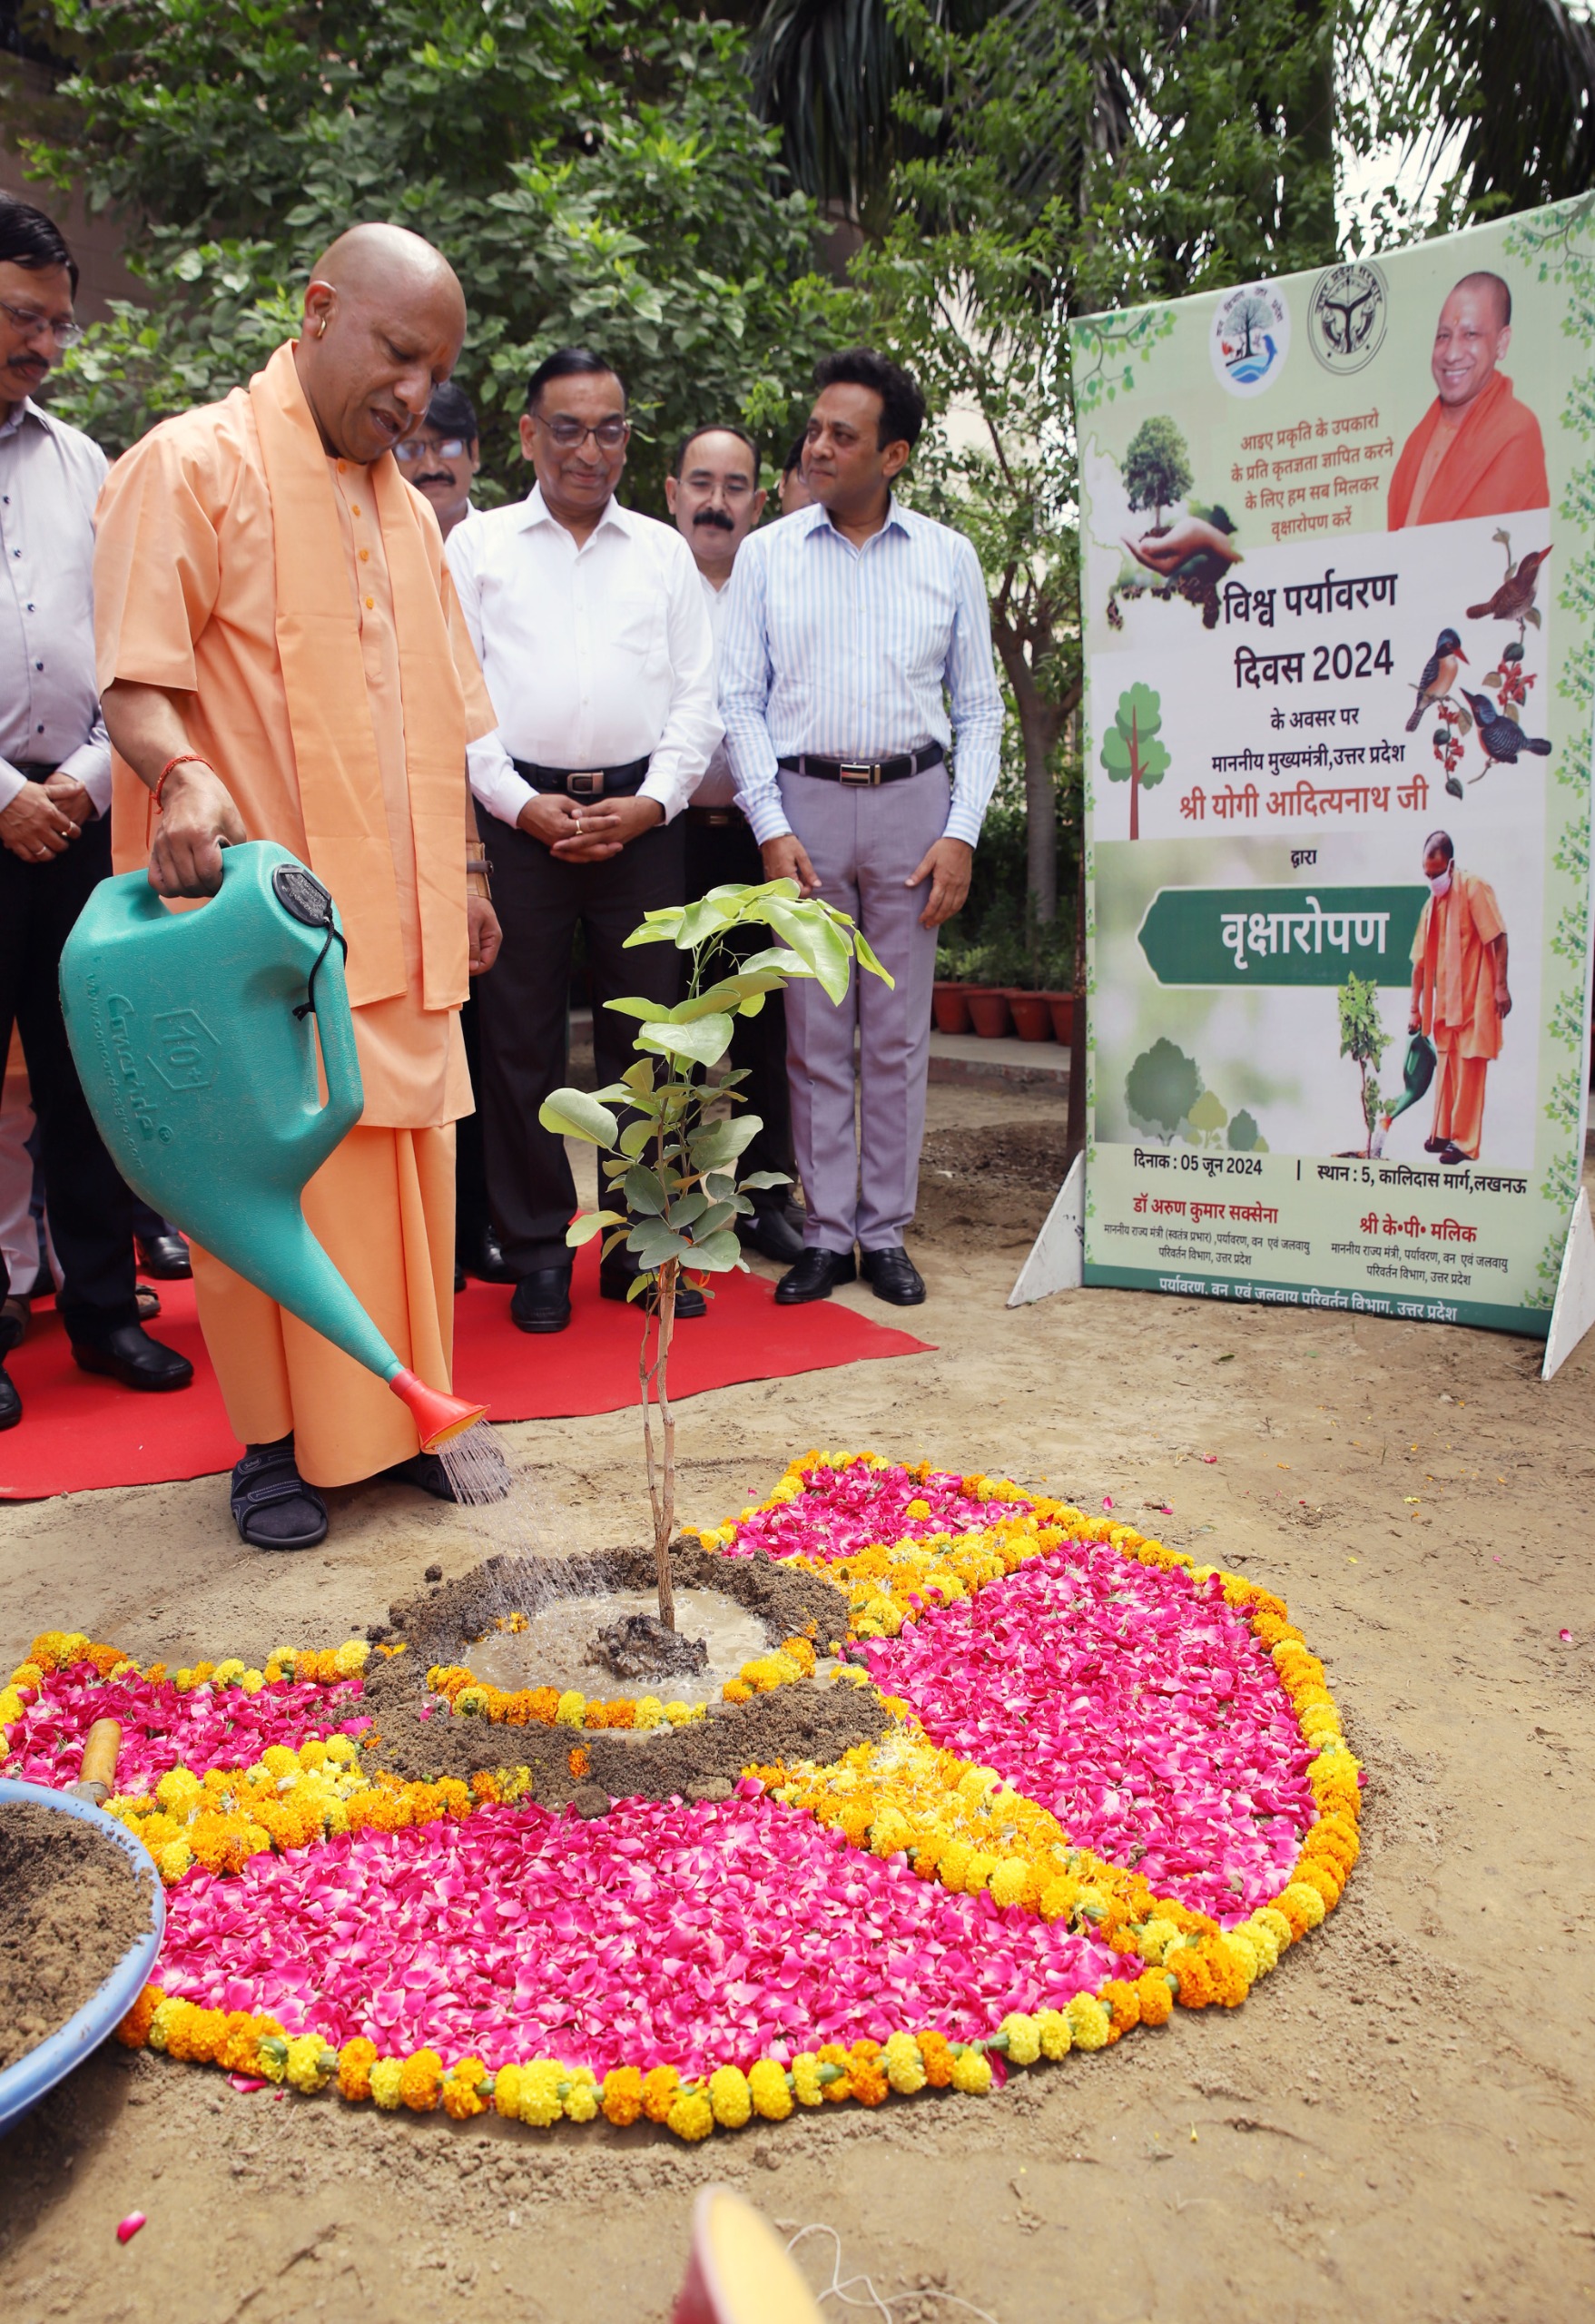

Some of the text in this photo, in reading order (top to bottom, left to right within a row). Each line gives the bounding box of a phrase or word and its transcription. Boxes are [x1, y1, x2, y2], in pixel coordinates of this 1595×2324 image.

[1241, 407, 1379, 450] आइए प्रकृति के उपकारो
[1231, 436, 1394, 482] के प्रति कृतज्ञता ज्ञापित करने
[1245, 476, 1380, 509] के लिए हम सब मिलकर
[1271, 506, 1353, 542] वृक्षारोपण करें
[1223, 568, 1398, 627] विश्व पर्यावरण
[1234, 639, 1394, 690] दिवस 2024
[1271, 707, 1360, 730] के अवसर पर
[1212, 748, 1265, 773] माननीय
[1369, 739, 1405, 763] प्रदेश
[1180, 773, 1429, 820] श्री योगी आदित्यनाथ जी
[1291, 850, 1317, 869] द्वारा
[1221, 896, 1390, 970] वृक्षारोपण
[1134, 1147, 1170, 1168] दिनाक
[1180, 1155, 1198, 1171] 05
[1203, 1157, 1224, 1177] जून
[1226, 1157, 1263, 1176] 2024
[1317, 1165, 1350, 1181] स्थान
[1361, 1167, 1374, 1187] 5,
[1379, 1165, 1440, 1187] कालिदास
[1133, 1192, 1278, 1224] डॉ अरुण कुमार सक्सेना
[1104, 1222, 1129, 1236] माननीय
[1131, 1226, 1148, 1237] राज्य
[1149, 1226, 1164, 1238] मंत्री
[1165, 1226, 1188, 1241] (स्वतंत्र
[1190, 1231, 1212, 1244] प्रभार)
[1251, 1236, 1264, 1247] वन
[1267, 1236, 1279, 1250] एवं
[1281, 1239, 1310, 1256] जलवायु
[1360, 1212, 1378, 1234] श्री
[1431, 1218, 1478, 1243] मलिक
[1158, 1245, 1252, 1265] परिवर्तन विभाग, उत्तर प्रदेश
[1331, 1241, 1508, 1273] माननीय राज्य मंत्री, पर्यावरण, वन एवं जलवायु
[1366, 1263, 1472, 1285] परिवर्तन विभाग, उत्तर प्रदेश
[1211, 1283, 1229, 1296] वन
[1235, 1282, 1253, 1299] एवं
[1302, 1288, 1349, 1308] परिवर्तन
[1397, 1301, 1424, 1318] उत्तर
[1427, 1301, 1458, 1322] प्रदेश
